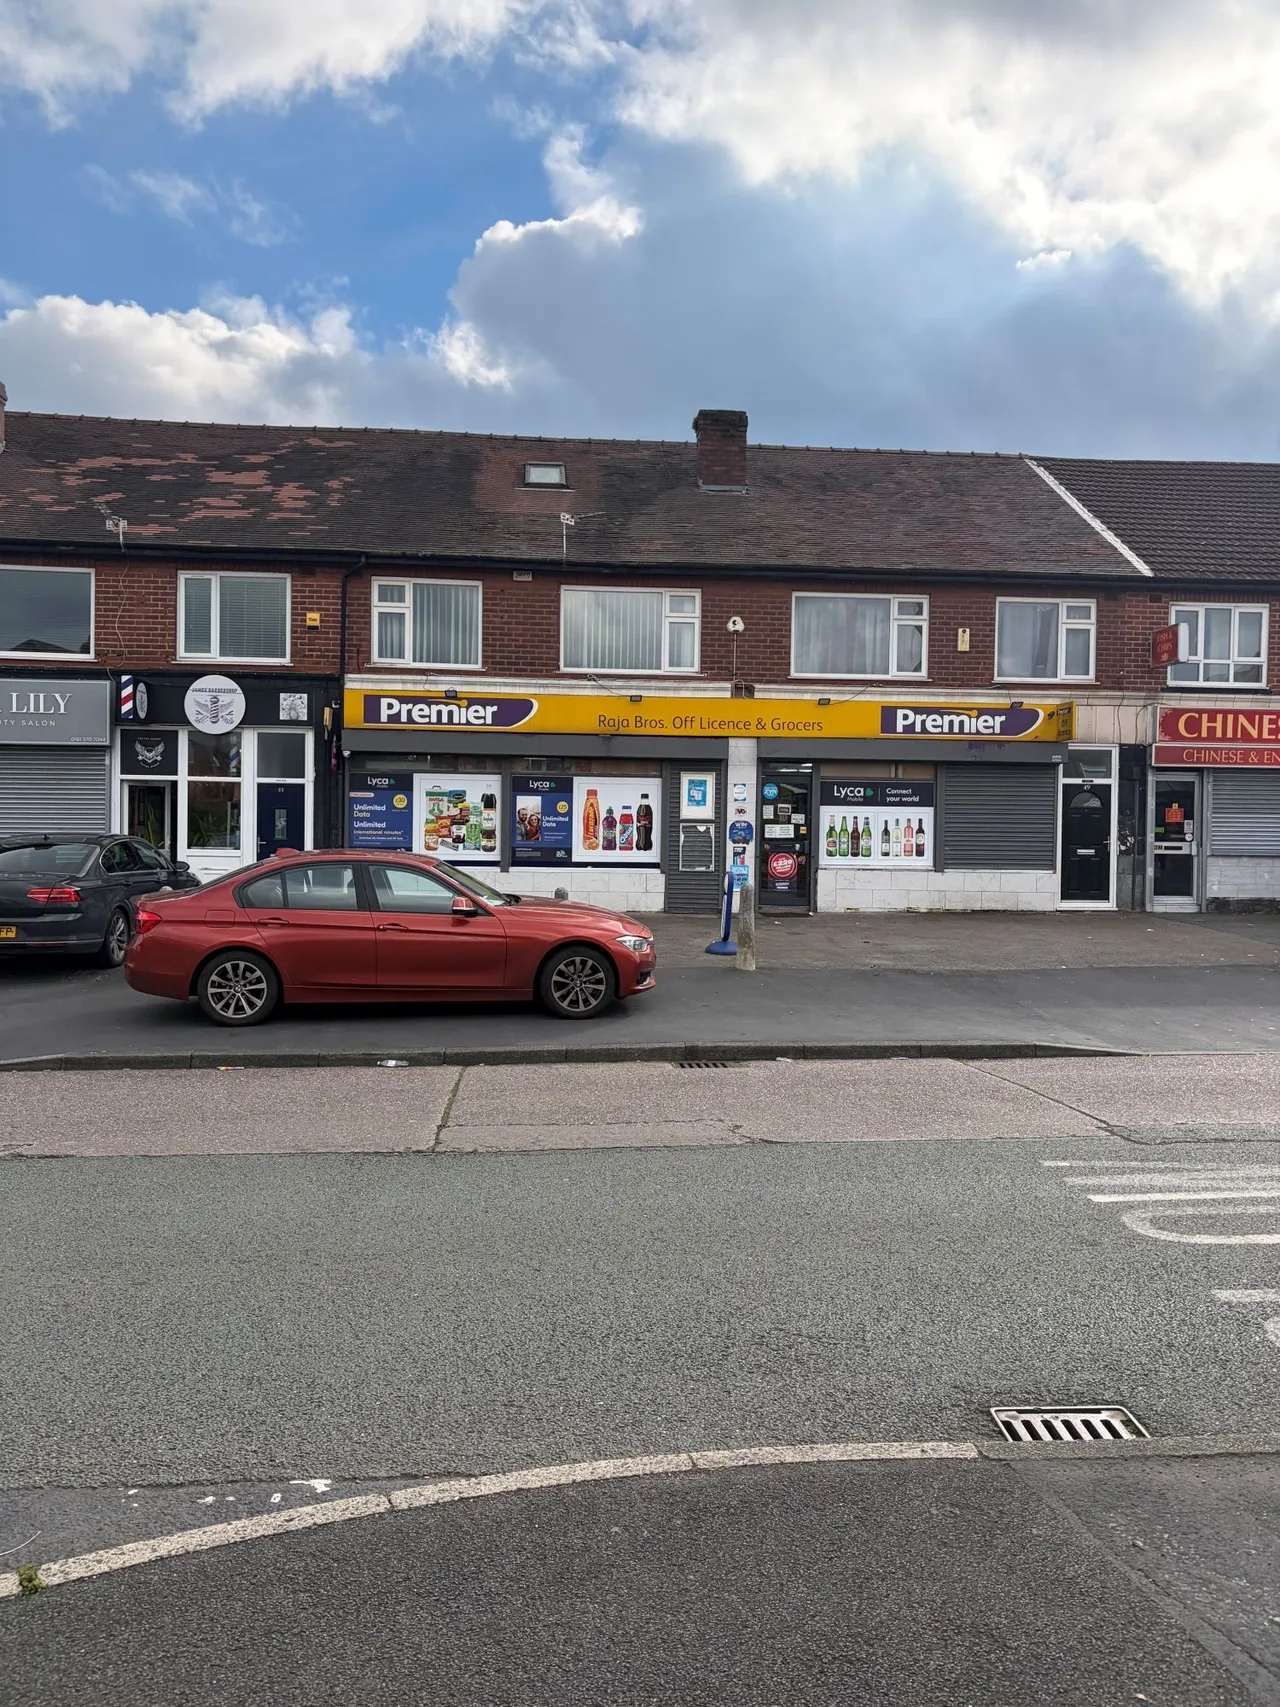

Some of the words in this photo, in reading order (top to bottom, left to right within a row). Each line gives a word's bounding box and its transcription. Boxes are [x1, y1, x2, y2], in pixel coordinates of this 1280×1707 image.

[10, 692, 72, 714] LILY
[380, 697, 498, 725] Premier
[598, 715, 630, 732] Raja
[634, 716, 668, 729] Bros.
[672, 716, 696, 729] Off
[699, 717, 751, 731] Licence
[756, 718, 767, 731] &
[771, 718, 823, 731] Grocers
[896, 708, 1006, 734] Premier
[1178, 712, 1280, 739] CHINE
[1183, 749, 1244, 763] CHINESE
[1248, 751, 1259, 763] &
[367, 776, 389, 786] Lyca
[529, 780, 550, 789] Lyca
[834, 785, 864, 798] Lyca
[886, 787, 912, 795] Connect
